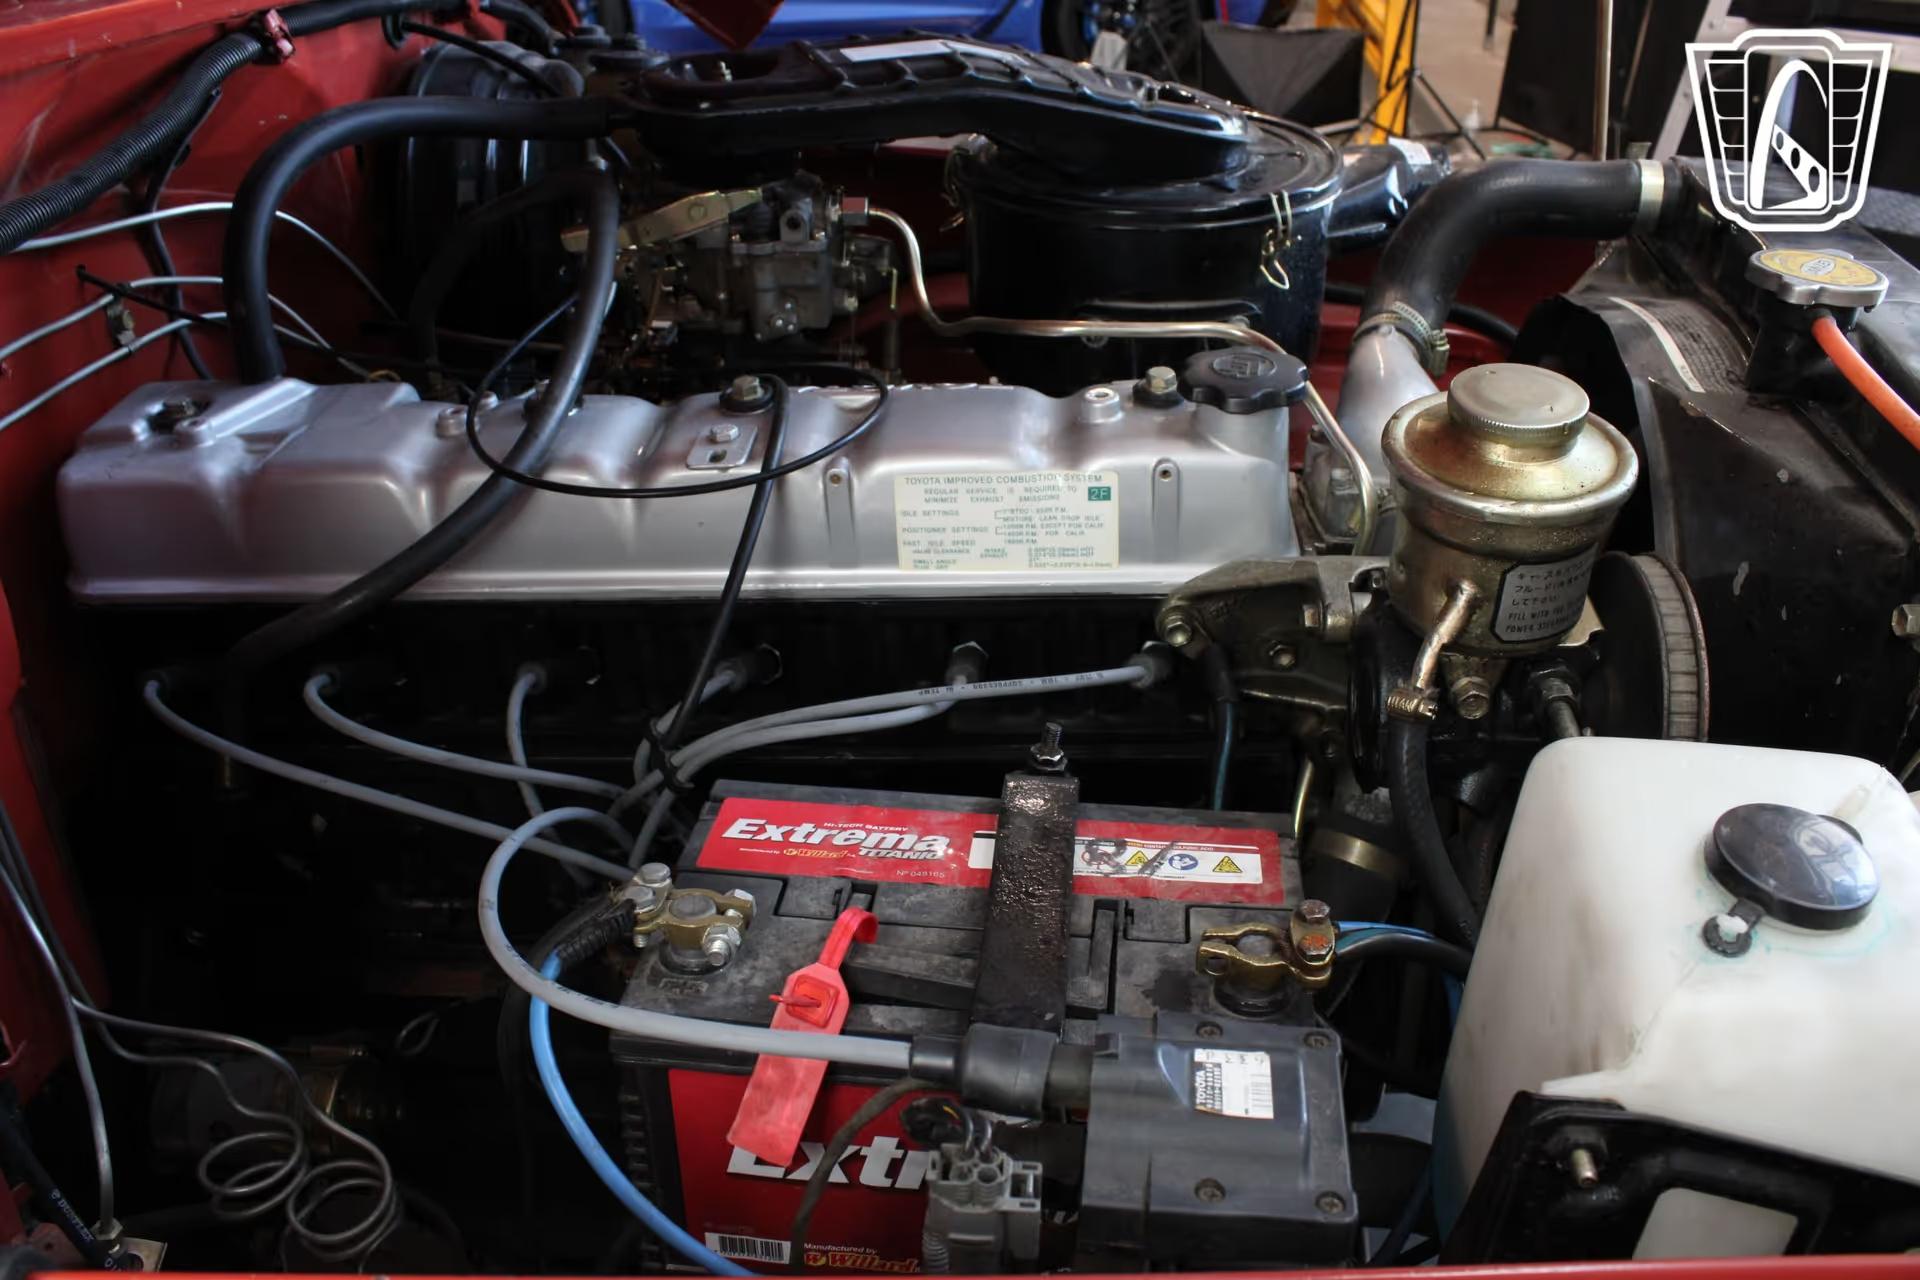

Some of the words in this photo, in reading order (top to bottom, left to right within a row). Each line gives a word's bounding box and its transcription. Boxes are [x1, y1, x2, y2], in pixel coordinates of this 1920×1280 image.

[904, 476, 941, 485] TOYOTA
[944, 475, 993, 484] IMPROVED
[1063, 473, 1102, 482] SYSTEM
[1090, 488, 1109, 500] 2F
[721, 818, 950, 852] Extrema
[1195, 1070, 1206, 1104] TOYOTA
[803, 1243, 862, 1254] Manufactured
[864, 1247, 878, 1255] by
